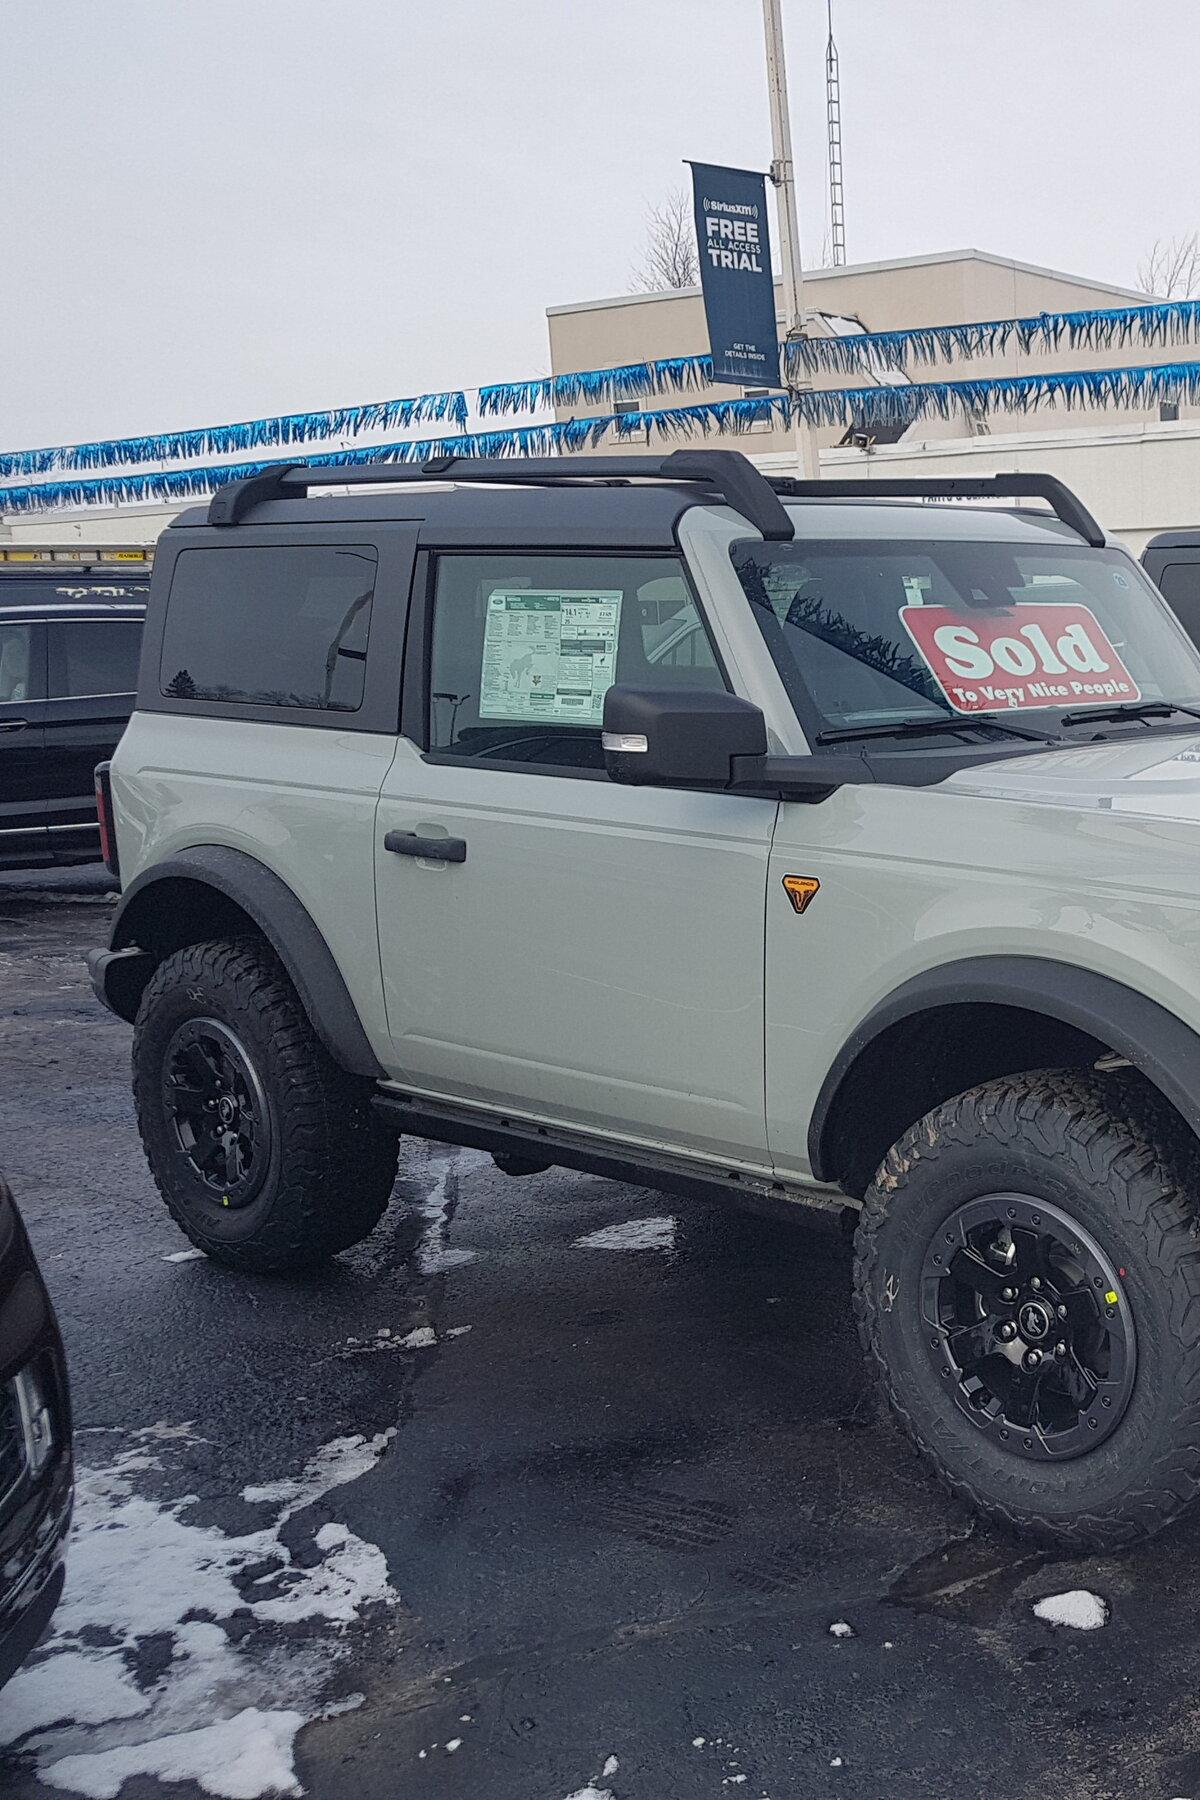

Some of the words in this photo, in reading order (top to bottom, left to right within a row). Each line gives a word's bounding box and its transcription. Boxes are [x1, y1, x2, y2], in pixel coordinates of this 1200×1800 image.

[705, 216, 759, 243] FREE
[707, 238, 725, 249] ALL
[727, 240, 761, 254] ACCESS
[707, 248, 763, 273] TRIAL
[724, 350, 747, 359] DETAILS
[733, 343, 744, 351] GET
[745, 344, 756, 352] THE
[933, 623, 1110, 680] Sold
[952, 687, 978, 703] To
[979, 685, 1025, 702] Very
[1027, 681, 1069, 698] Nice
[1069, 679, 1130, 696] People
